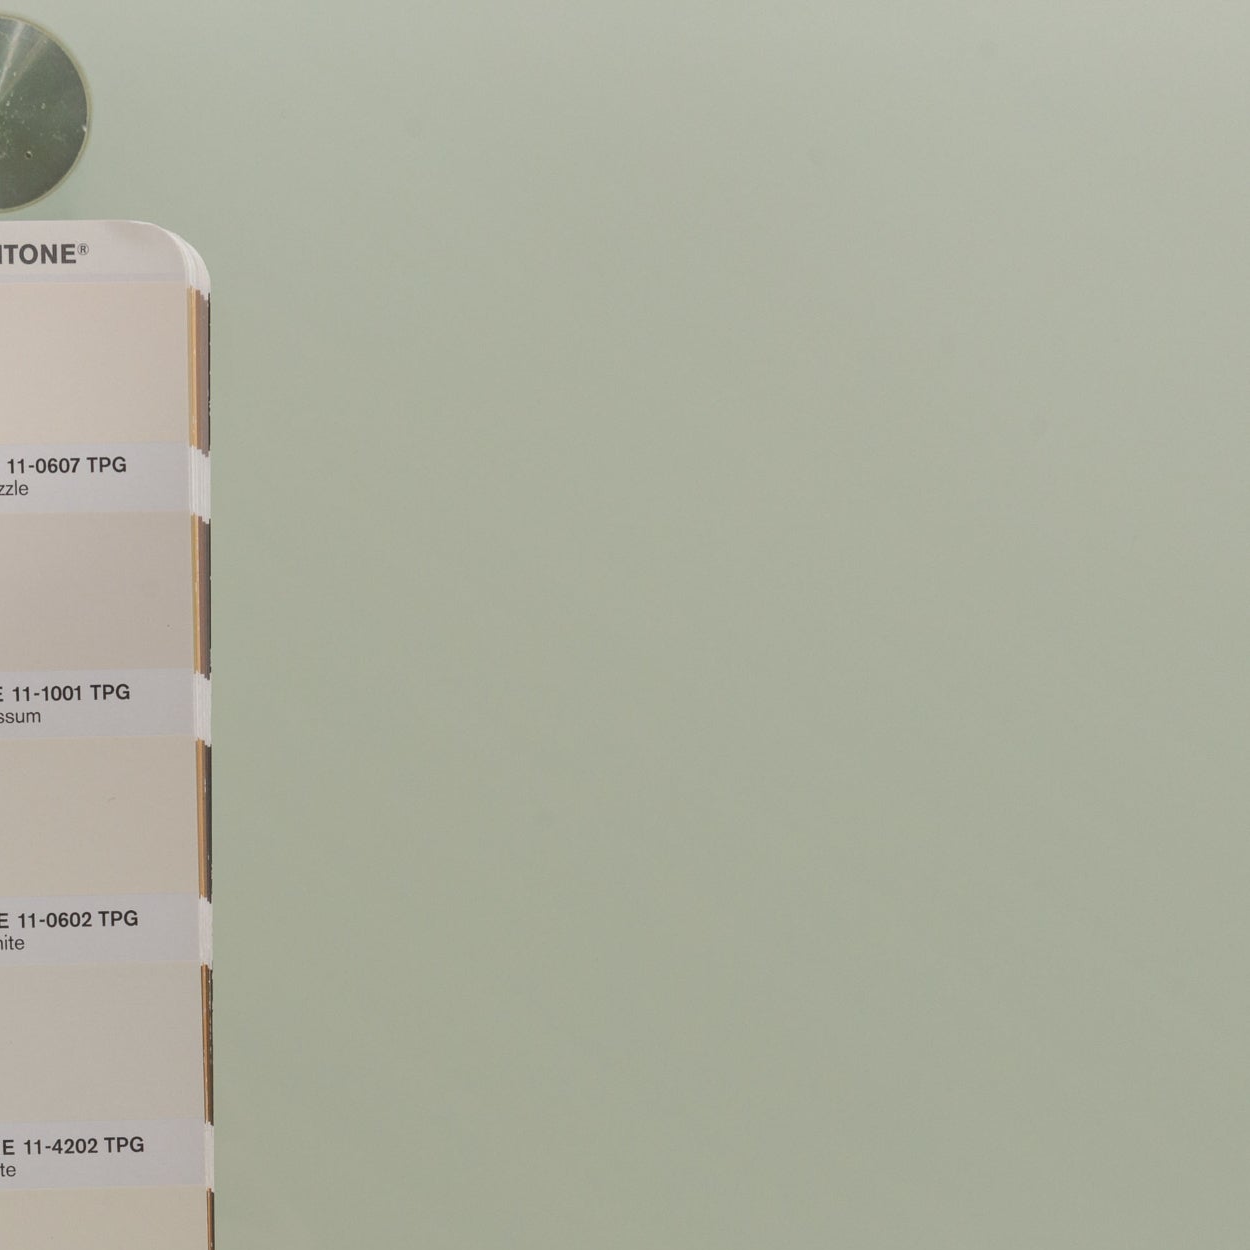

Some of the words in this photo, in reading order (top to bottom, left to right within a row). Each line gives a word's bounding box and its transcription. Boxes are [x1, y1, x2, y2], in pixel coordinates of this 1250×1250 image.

[7, 457, 81, 475] 11-0607
[86, 455, 127, 473] TPG
[12, 685, 82, 702] 11-1001
[89, 683, 131, 701] TPG
[17, 911, 93, 929] 11-0602
[97, 909, 139, 927] TPG
[23, 1137, 99, 1156] 11-4202
[103, 1135, 145, 1154] TPG
